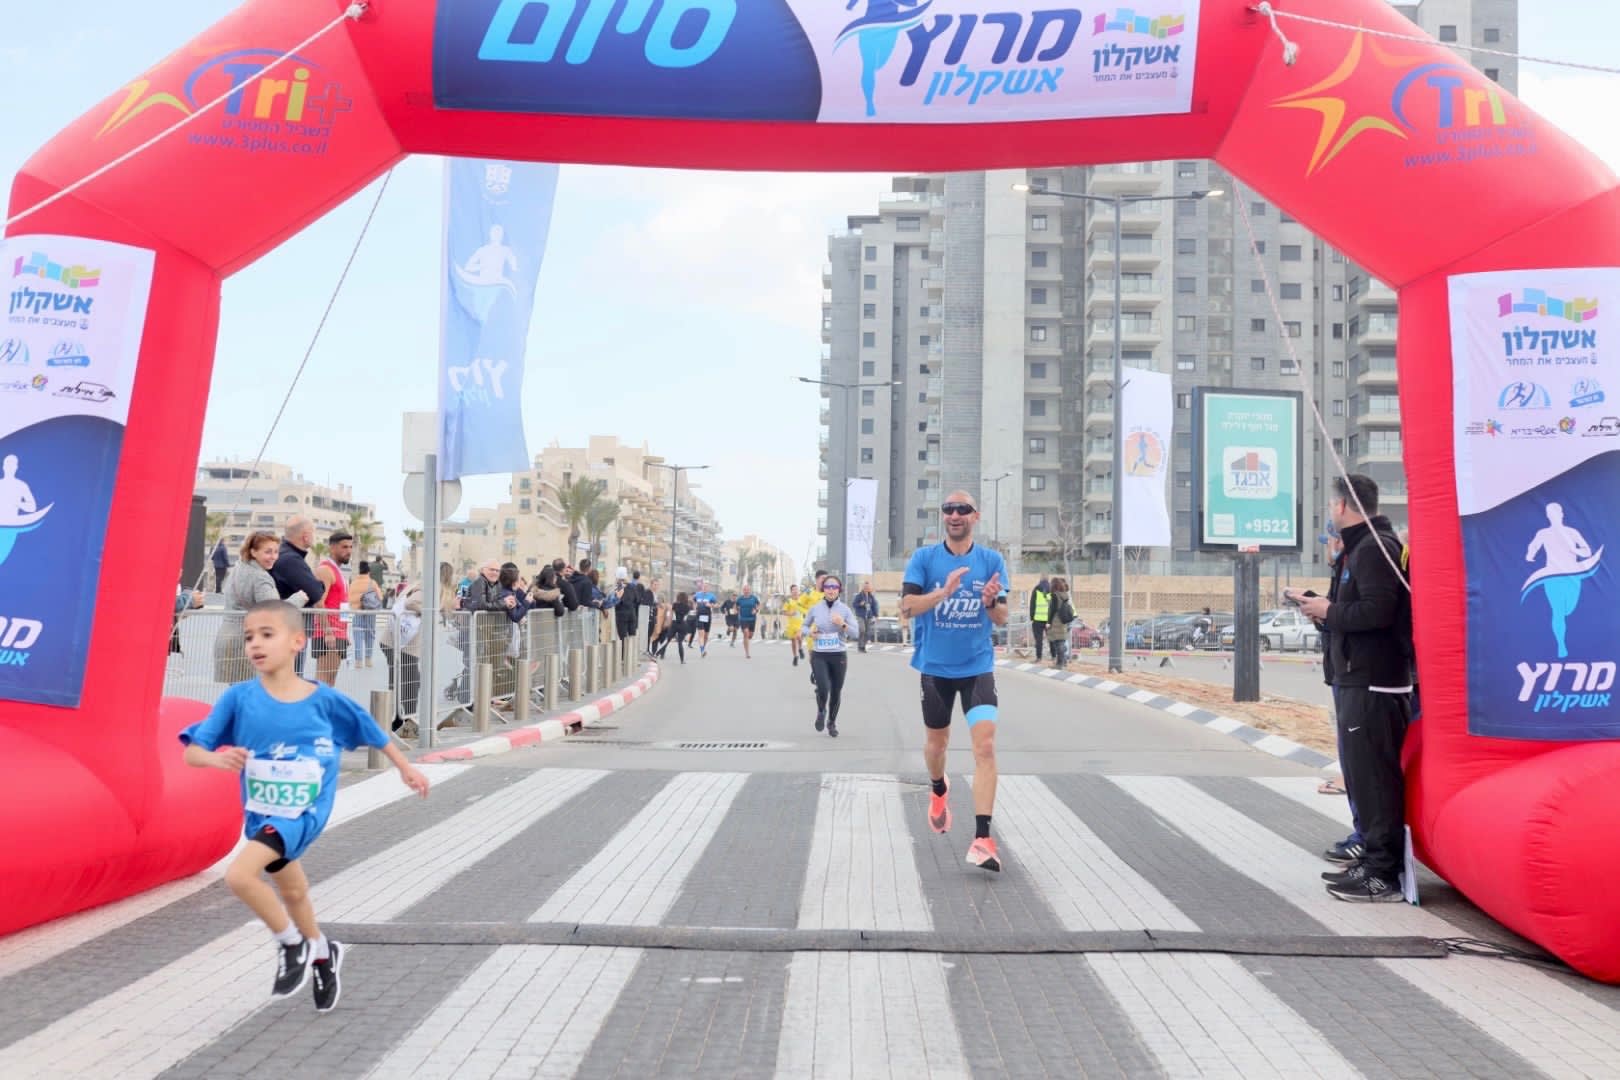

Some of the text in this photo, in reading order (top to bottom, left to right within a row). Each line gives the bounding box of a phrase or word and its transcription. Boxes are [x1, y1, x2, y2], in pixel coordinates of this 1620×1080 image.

[477, 0, 738, 68] סיום
[899, 8, 1083, 87] מרוץ
[1092, 43, 1180, 74] אשקלון
[922, 64, 1065, 106] אשקלון
[9, 286, 94, 315] אשקלון
[1502, 325, 1597, 356] אשקלון
[943, 598, 980, 616] מרוץ
[1516, 661, 1617, 702] מרוץ
[1533, 690, 1611, 713] אשקלון
[252, 782, 311, 806] 2035
